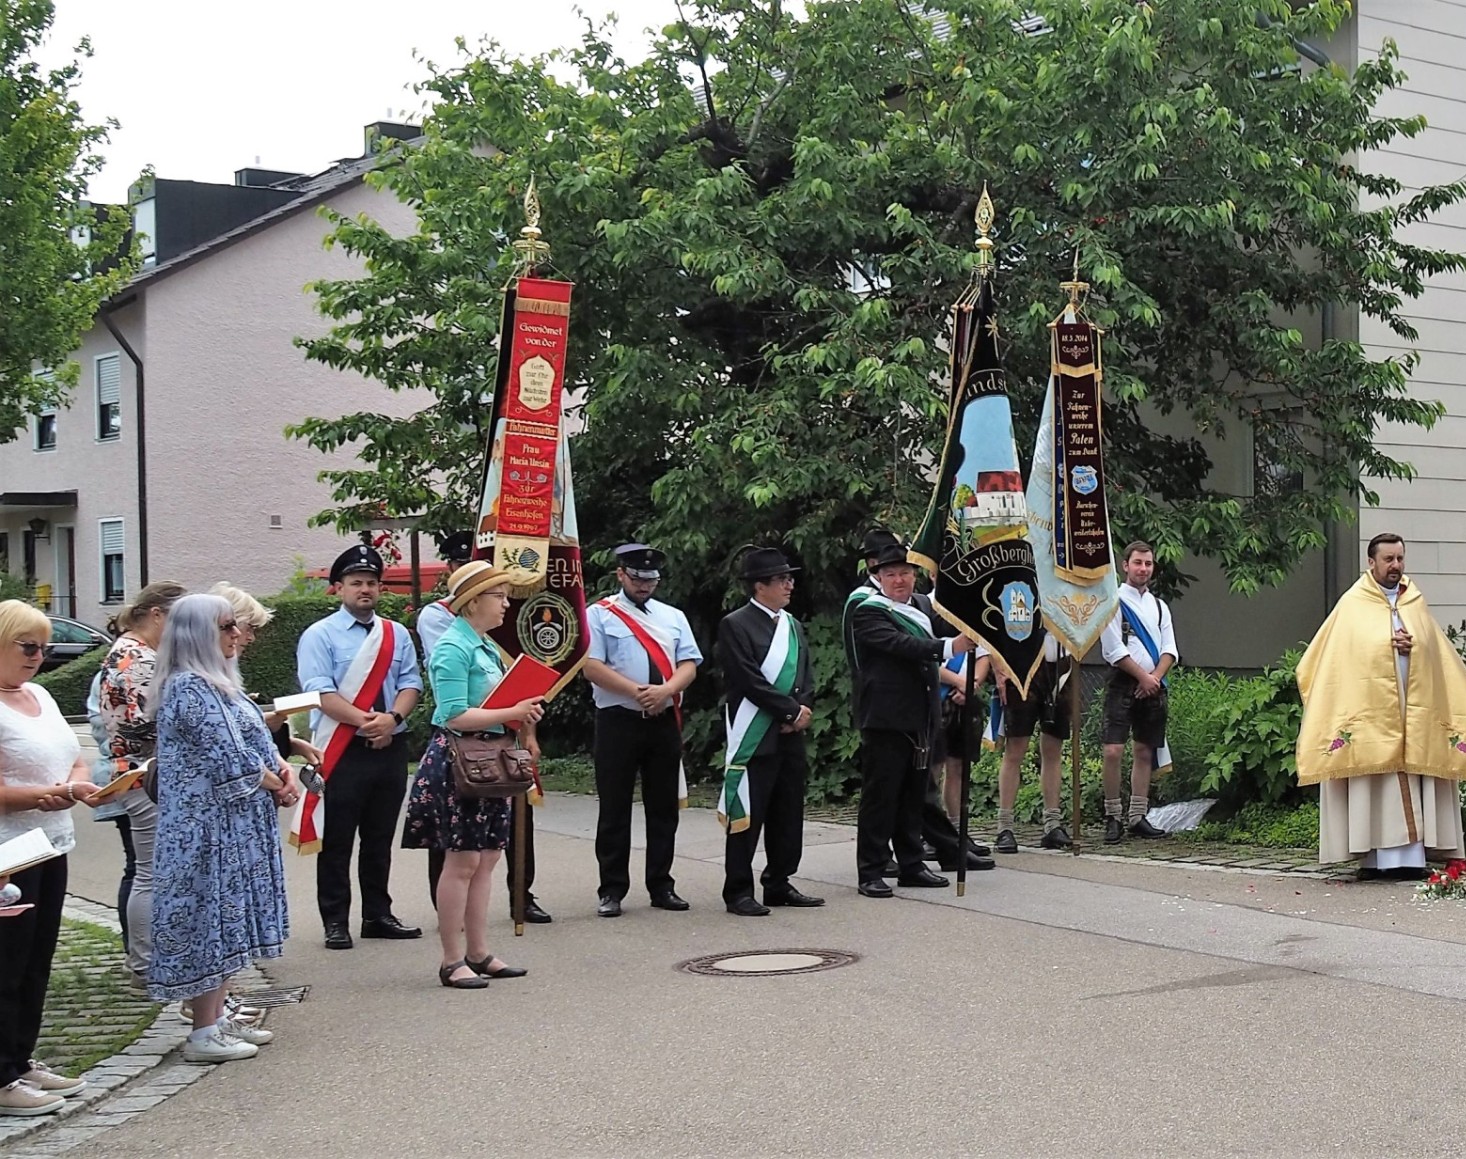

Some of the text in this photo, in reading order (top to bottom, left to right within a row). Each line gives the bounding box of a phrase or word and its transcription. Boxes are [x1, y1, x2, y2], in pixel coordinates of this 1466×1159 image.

[520, 322, 563, 336] Gewidmet
[1072, 389, 1086, 399] Zur
[1070, 432, 1094, 445] Paten
[522, 443, 540, 454] Frau
[509, 456, 529, 467] Maria
[957, 545, 1034, 582] Großbergh
